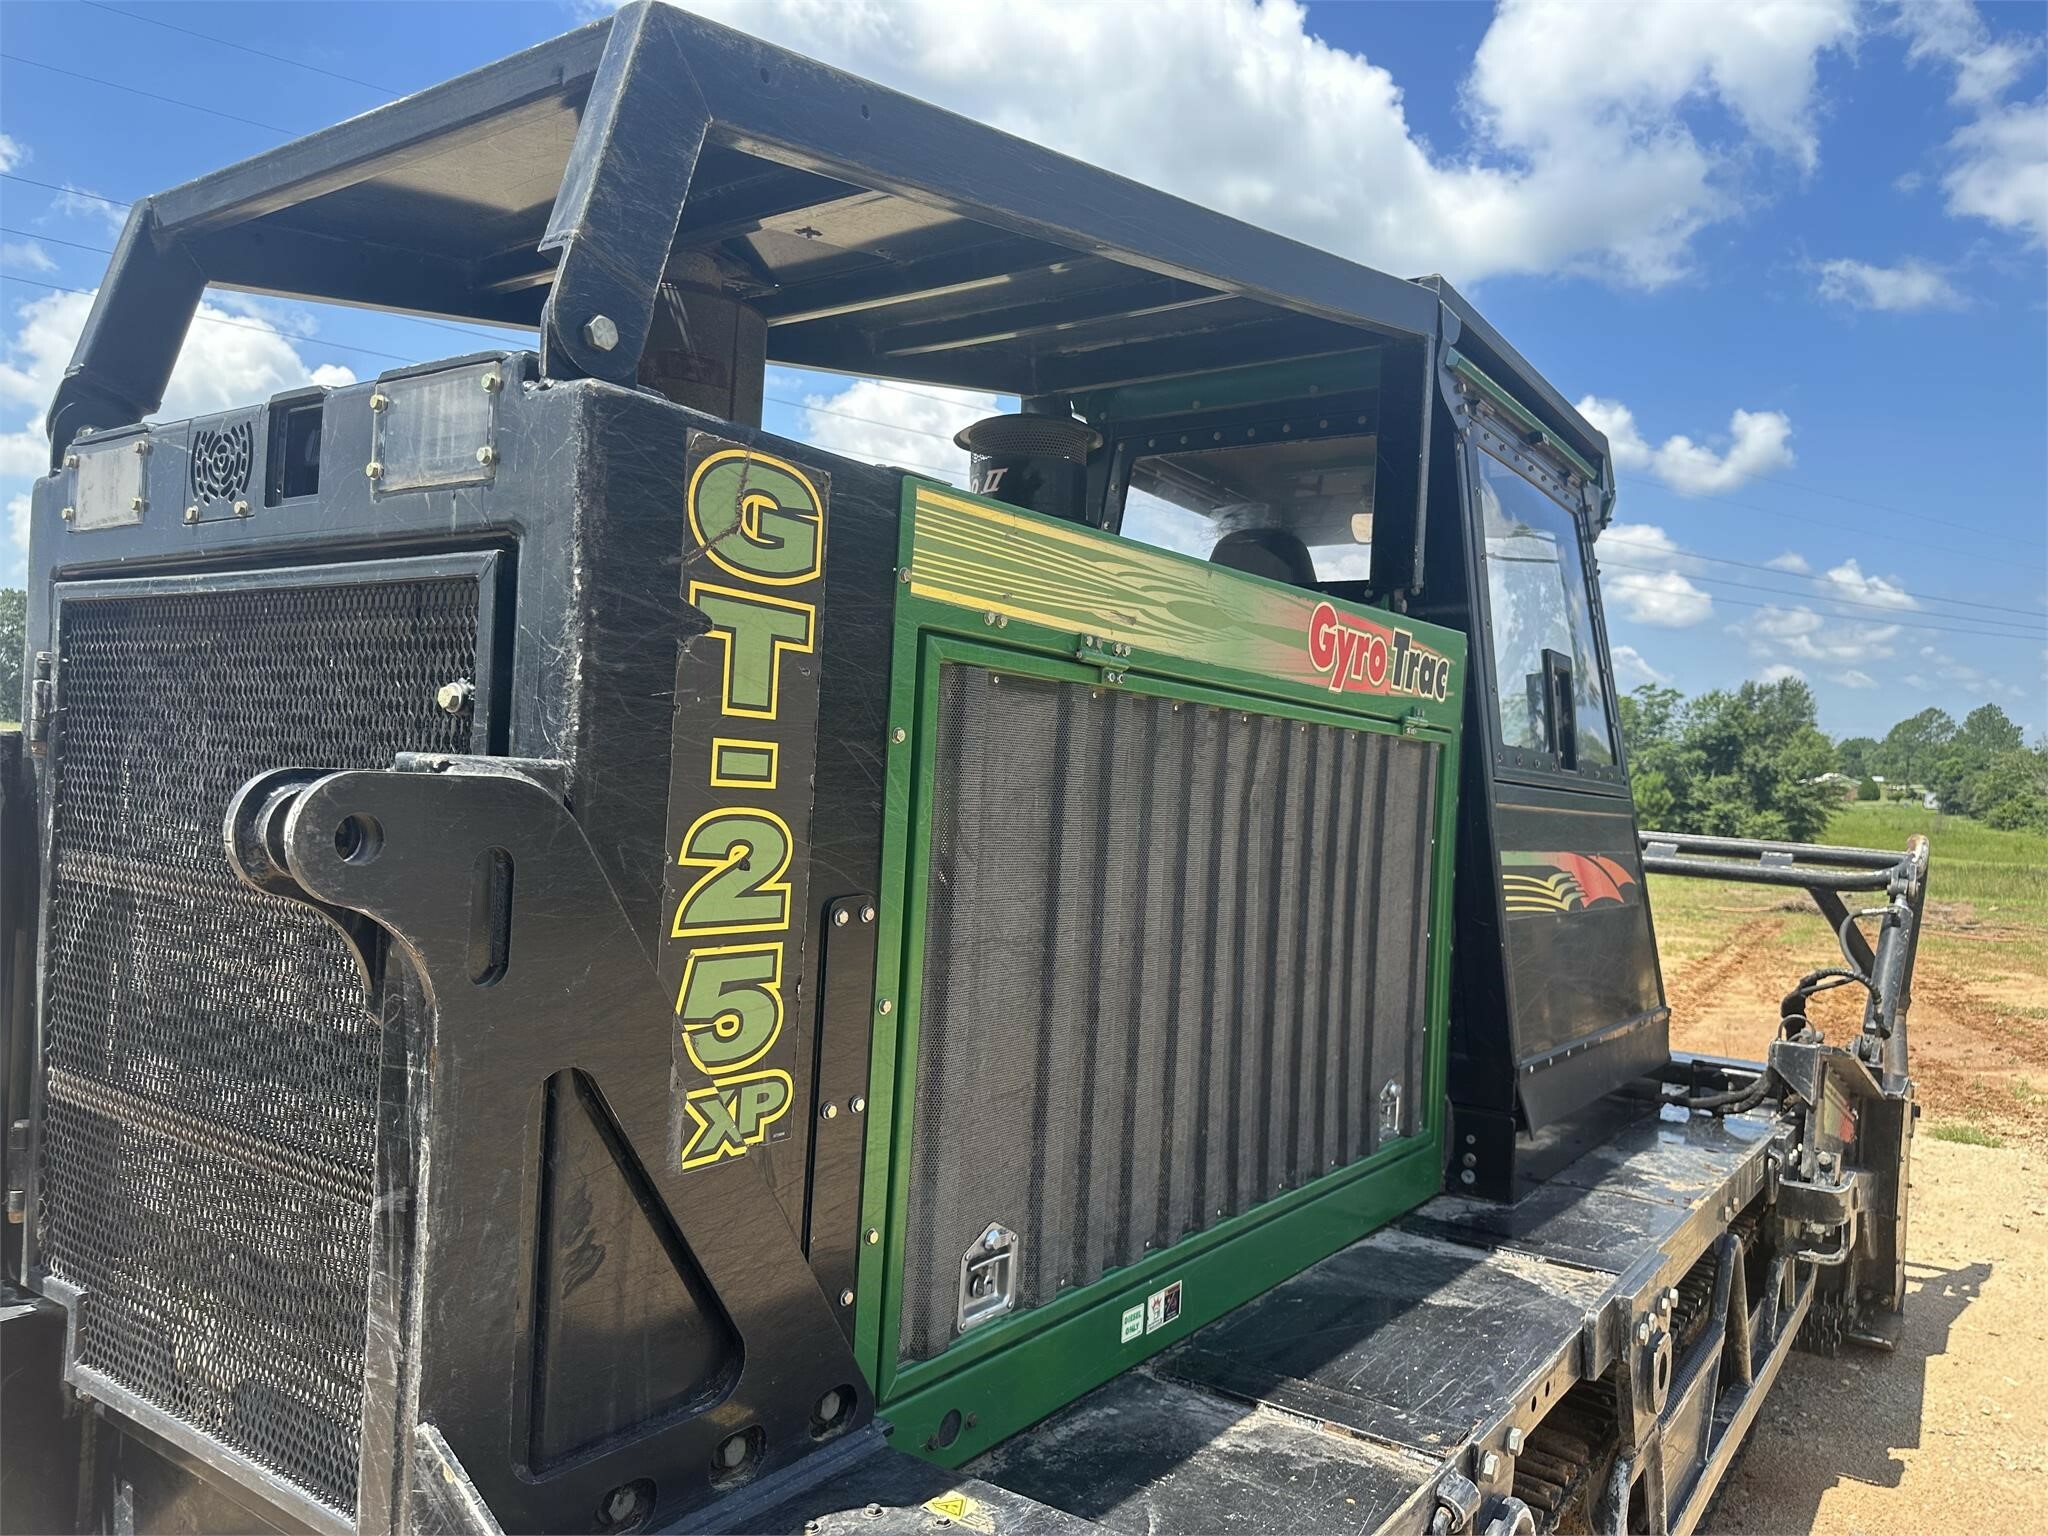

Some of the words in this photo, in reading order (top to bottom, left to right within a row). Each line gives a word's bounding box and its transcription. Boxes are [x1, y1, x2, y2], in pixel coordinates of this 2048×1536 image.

[1309, 601, 1388, 693] Gyro
[1391, 627, 1450, 703] Trac
[1124, 1311, 1142, 1325] DIESEL
[1125, 1322, 1140, 1335] ONLY
